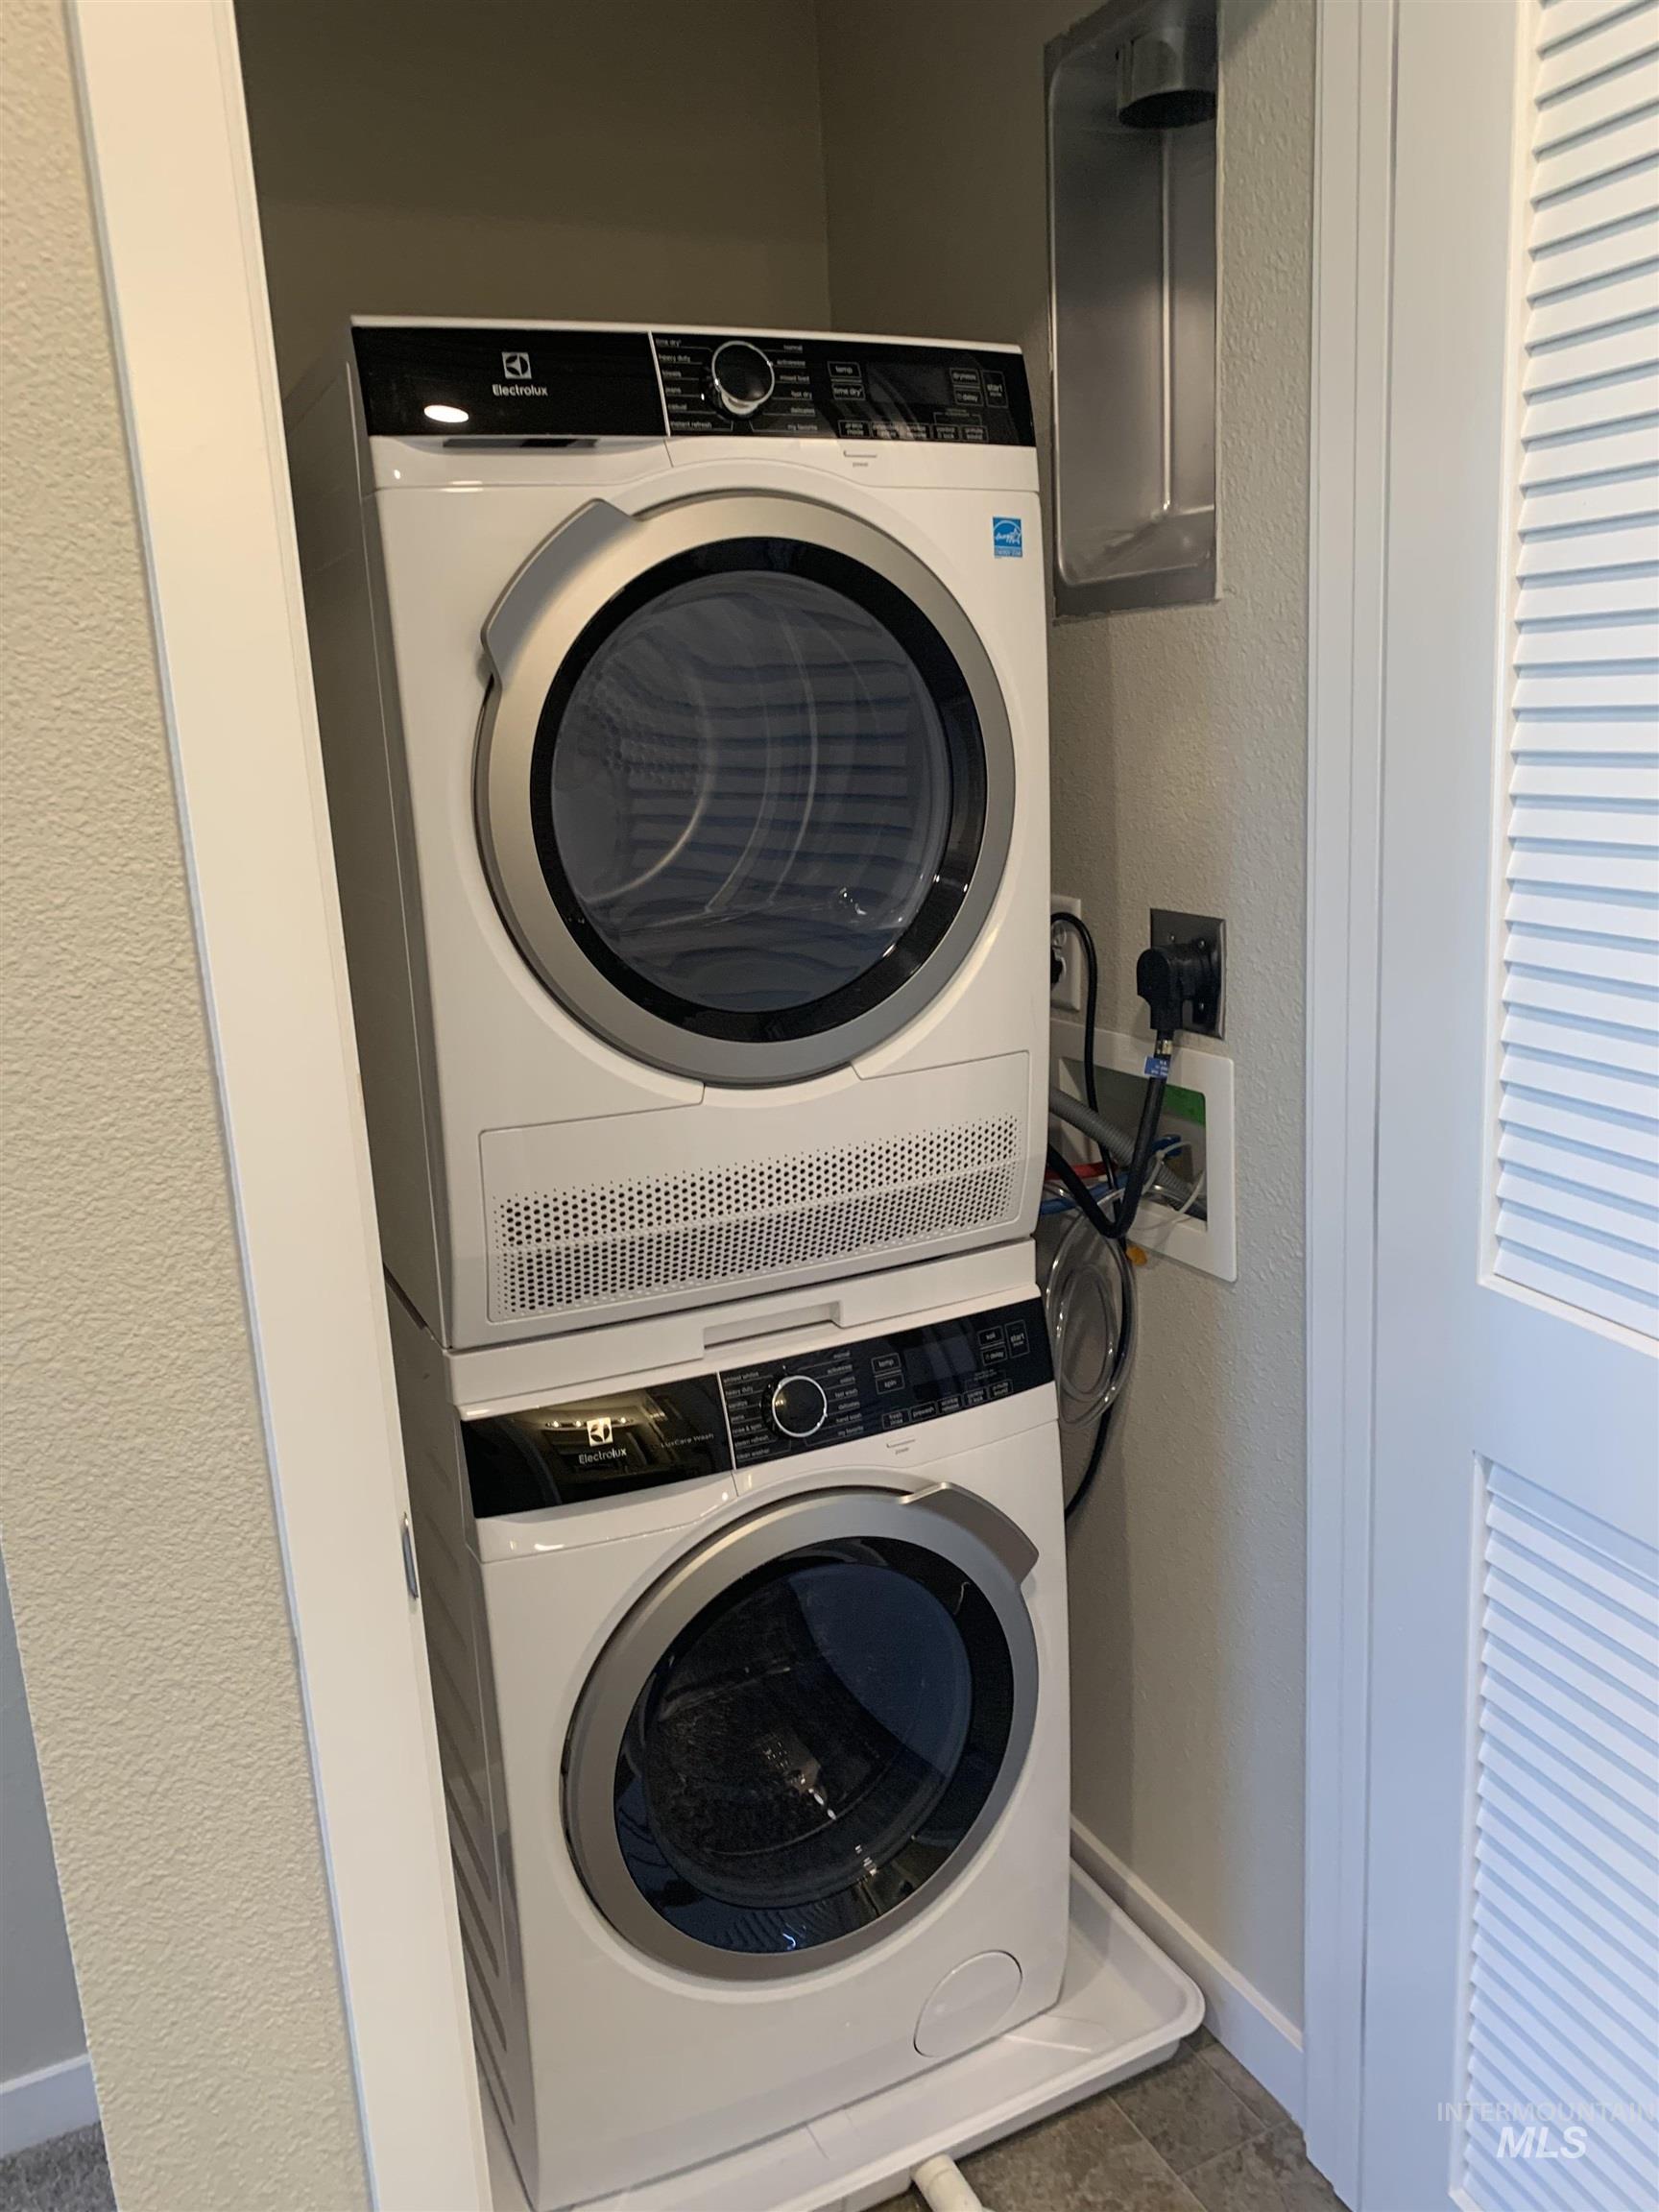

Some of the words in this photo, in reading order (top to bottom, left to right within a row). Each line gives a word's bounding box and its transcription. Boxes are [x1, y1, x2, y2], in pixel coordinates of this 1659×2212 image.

[834, 366, 854, 375] temp
[492, 383, 548, 397] Electrolux
[1010, 1333, 1024, 1343] start
[878, 1358, 895, 1368] temp
[693, 1432, 714, 1443] Wash
[578, 1447, 627, 1465] Electrolux
